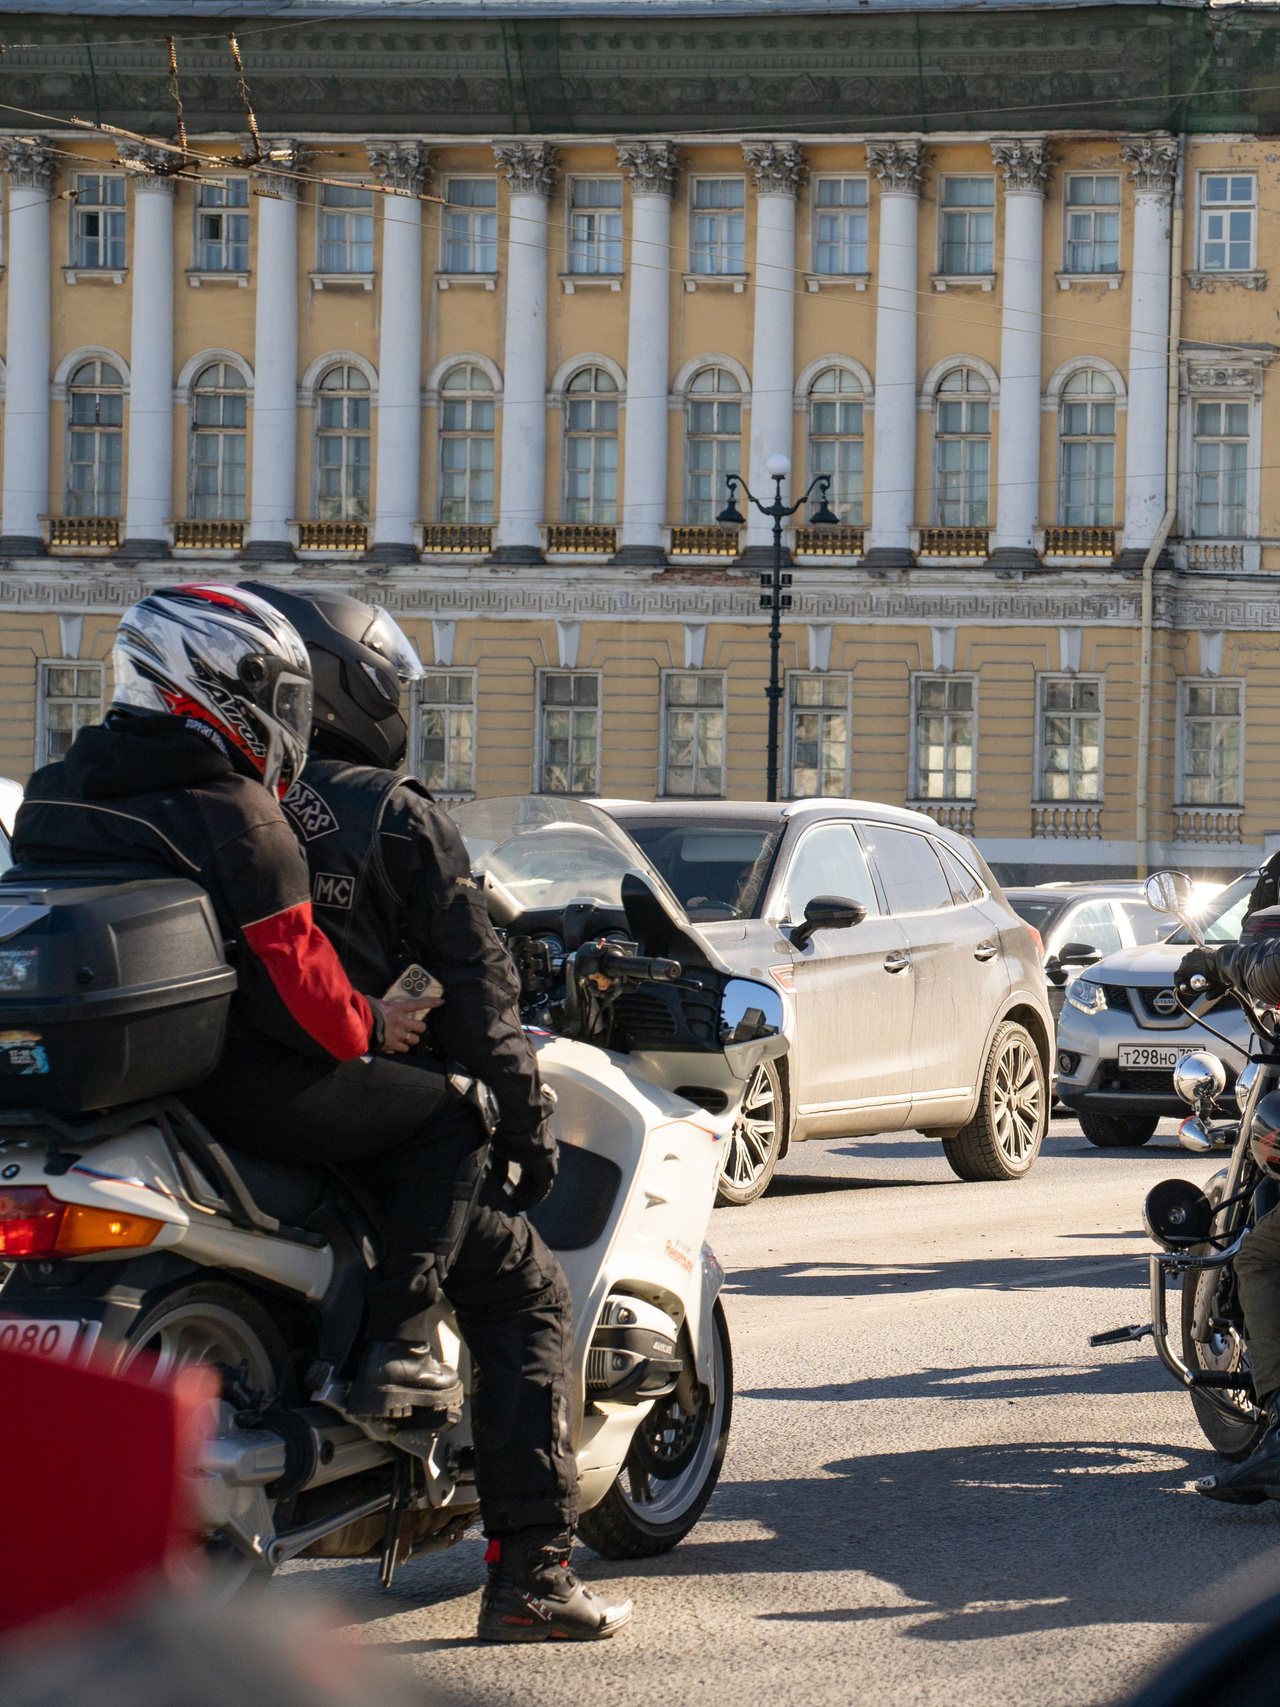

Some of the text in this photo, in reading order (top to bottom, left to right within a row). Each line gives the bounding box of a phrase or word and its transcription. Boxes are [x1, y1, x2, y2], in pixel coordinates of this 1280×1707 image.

[186, 675, 267, 757] Airoh
[282, 783, 331, 832] DERS
[316, 876, 350, 904] MC
[0, 1323, 60, 1356] 080
